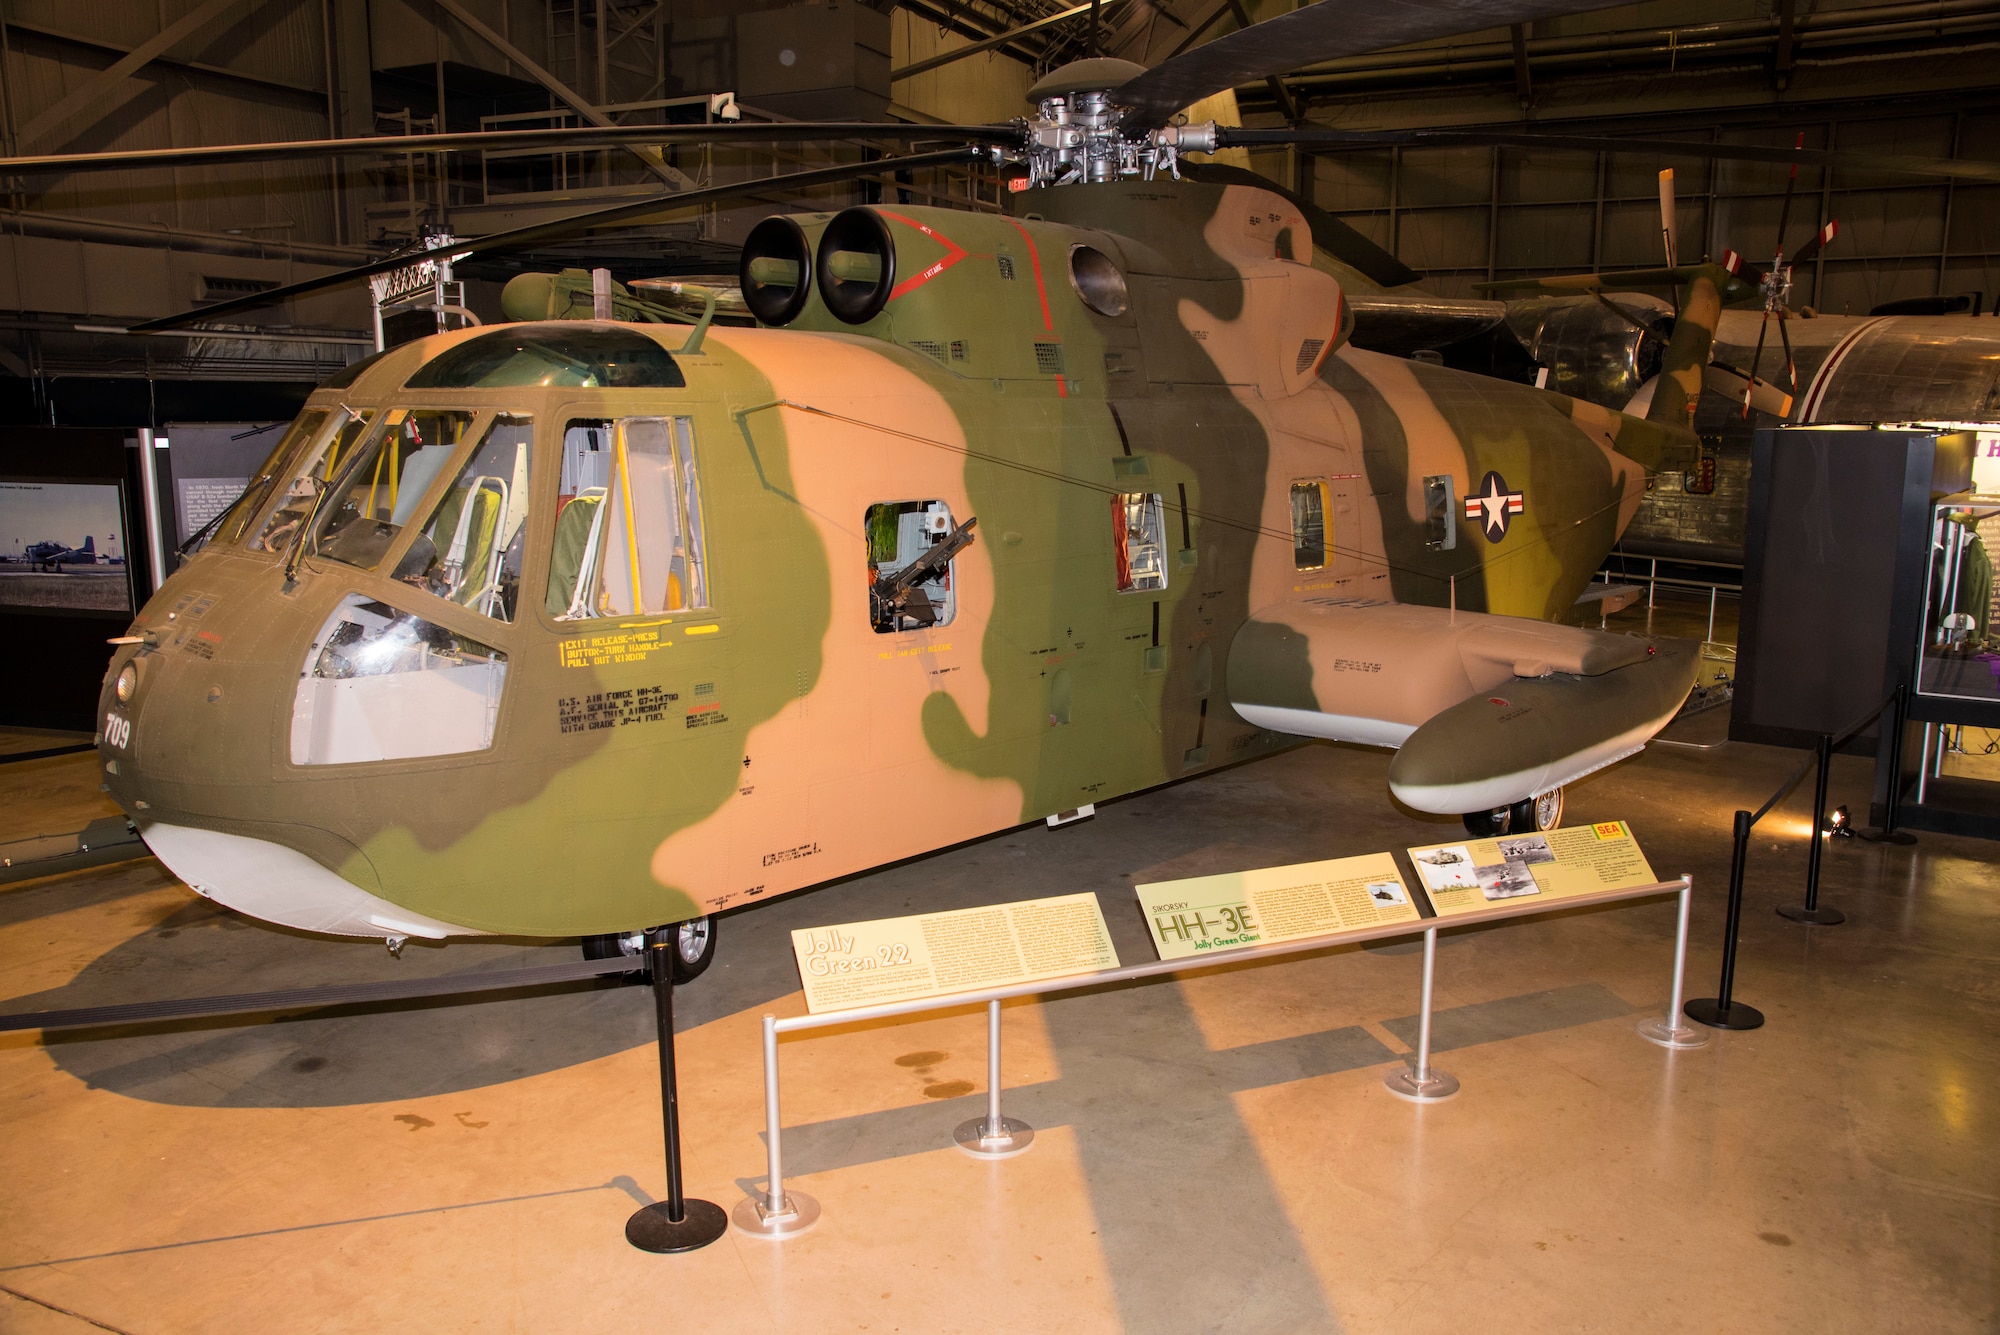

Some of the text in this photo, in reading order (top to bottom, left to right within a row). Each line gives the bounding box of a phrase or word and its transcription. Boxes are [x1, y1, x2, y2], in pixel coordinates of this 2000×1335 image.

[1014, 179, 1027, 190] EXIT
[565, 632, 658, 650] EXIT RELEASE-PRESS
[567, 641, 659, 659] BUTTON-TURN HANDLE
[567, 651, 646, 668] PULL OUT WINDOW
[559, 685, 662, 707] U.S. AIR FORCE HH-3E
[560, 702, 668, 725] SERVICE THIS AIRCRAFT
[587, 701, 619, 712] SERIAL
[105, 713, 130, 749] 709
[561, 723, 584, 734] WITH
[589, 719, 615, 730] GRADE
[645, 712, 666, 723] FUEL
[1597, 824, 1620, 835] SEA
[1152, 902, 1189, 913] SIKORSKY
[1154, 905, 1259, 944] HH-3E
[805, 929, 855, 955] Jolly
[1194, 933, 1262, 951] Jolly Green Giant
[806, 943, 912, 976] Green 22
